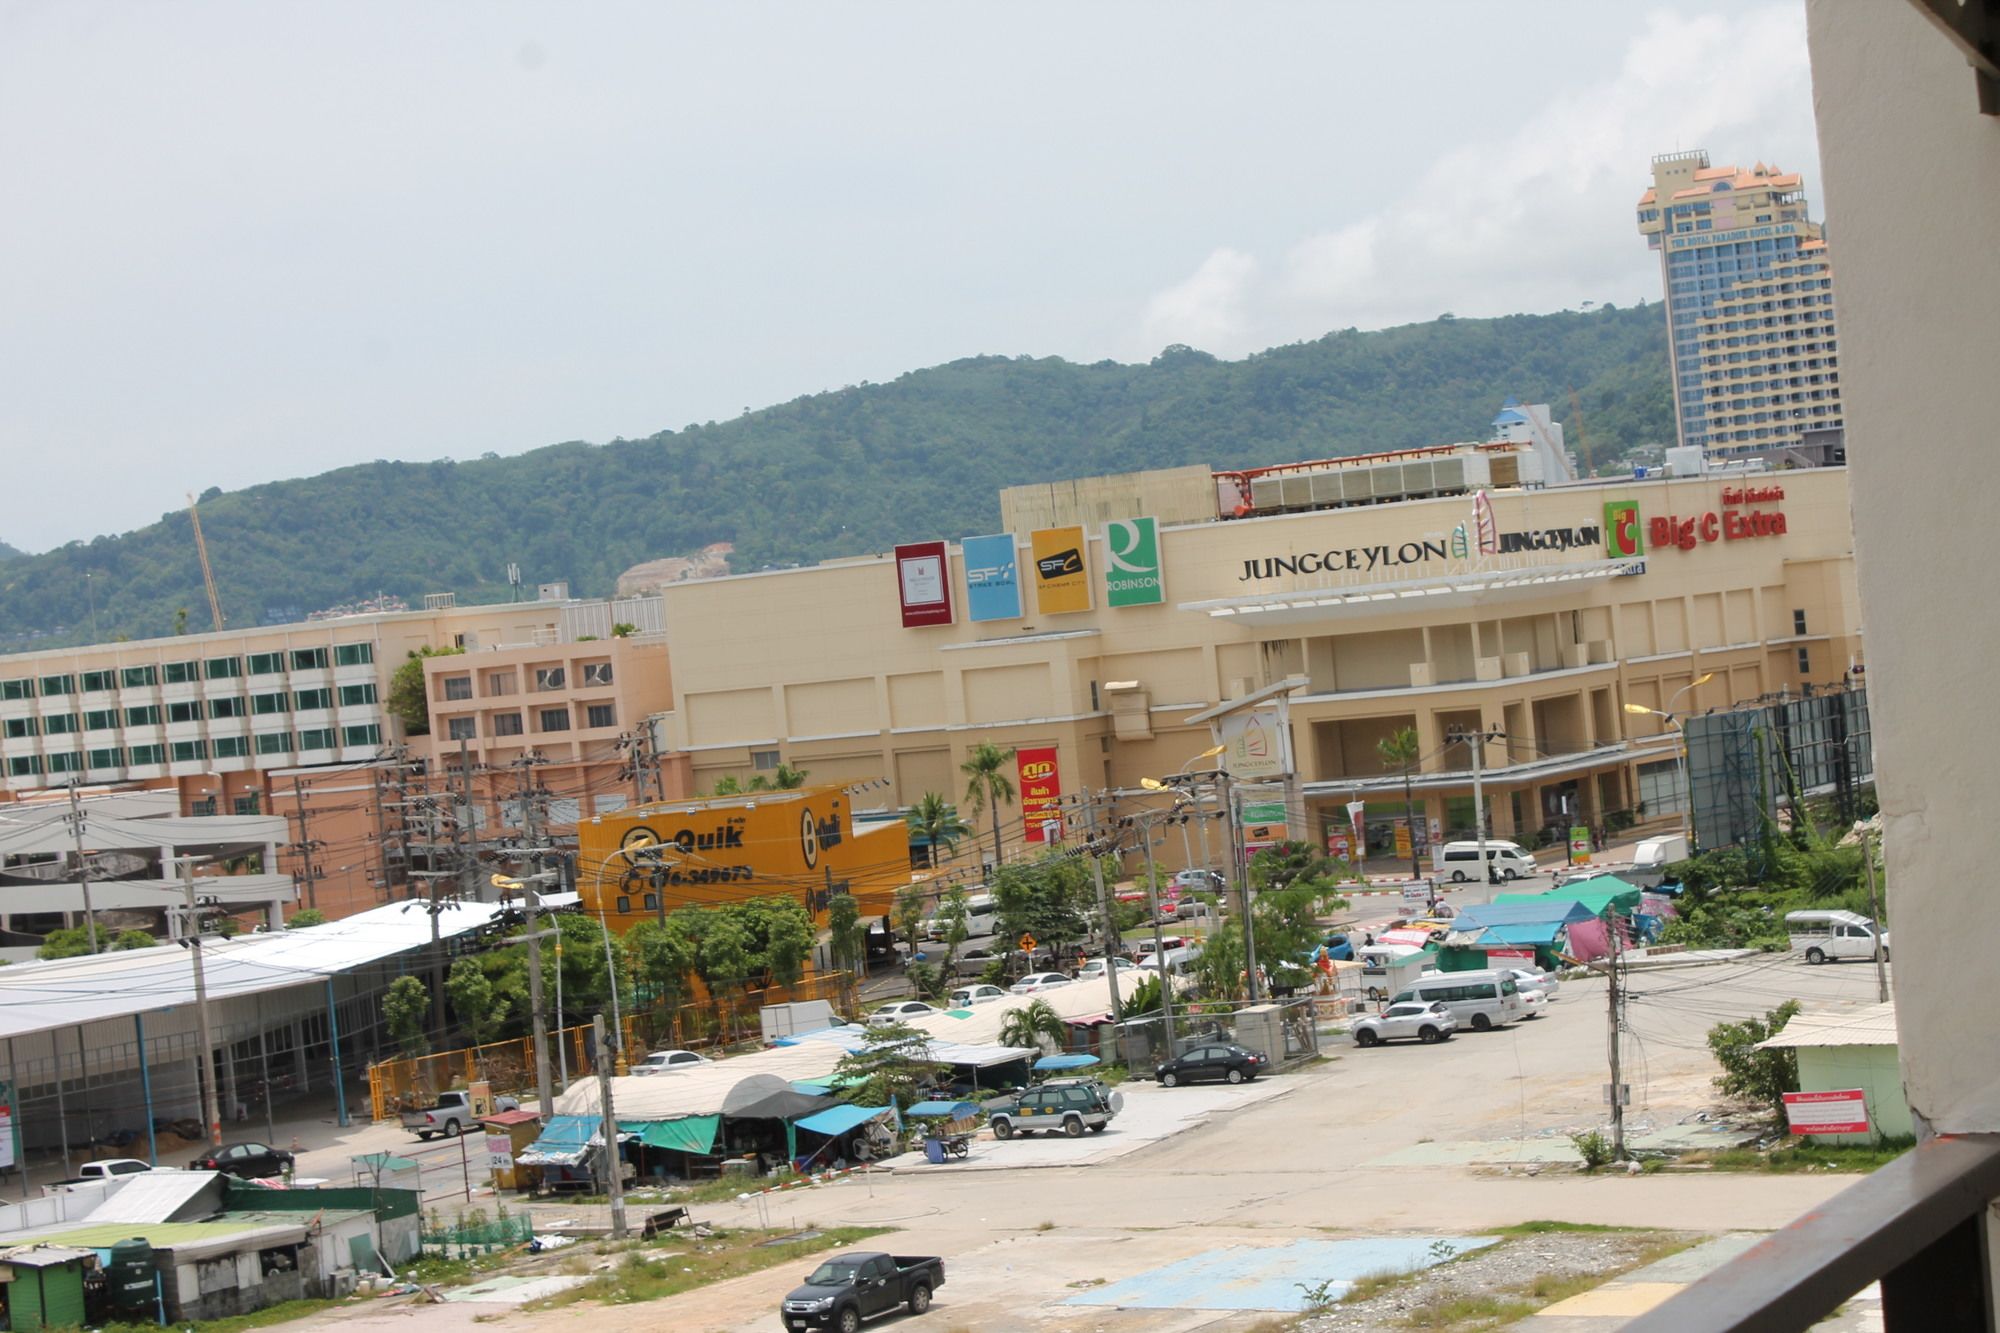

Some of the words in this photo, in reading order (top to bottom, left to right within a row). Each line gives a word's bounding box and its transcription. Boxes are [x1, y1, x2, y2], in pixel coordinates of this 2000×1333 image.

[1613, 510, 1626, 523] Big
[1498, 526, 1600, 553] JUNGCEYLON
[1650, 515, 1697, 551] Big
[1702, 512, 1719, 542] C
[1723, 509, 1787, 540] Extra
[1239, 539, 1448, 581] JUNGCEYLON
[967, 567, 998, 583] SF
[1106, 576, 1161, 592] ROBINSON
